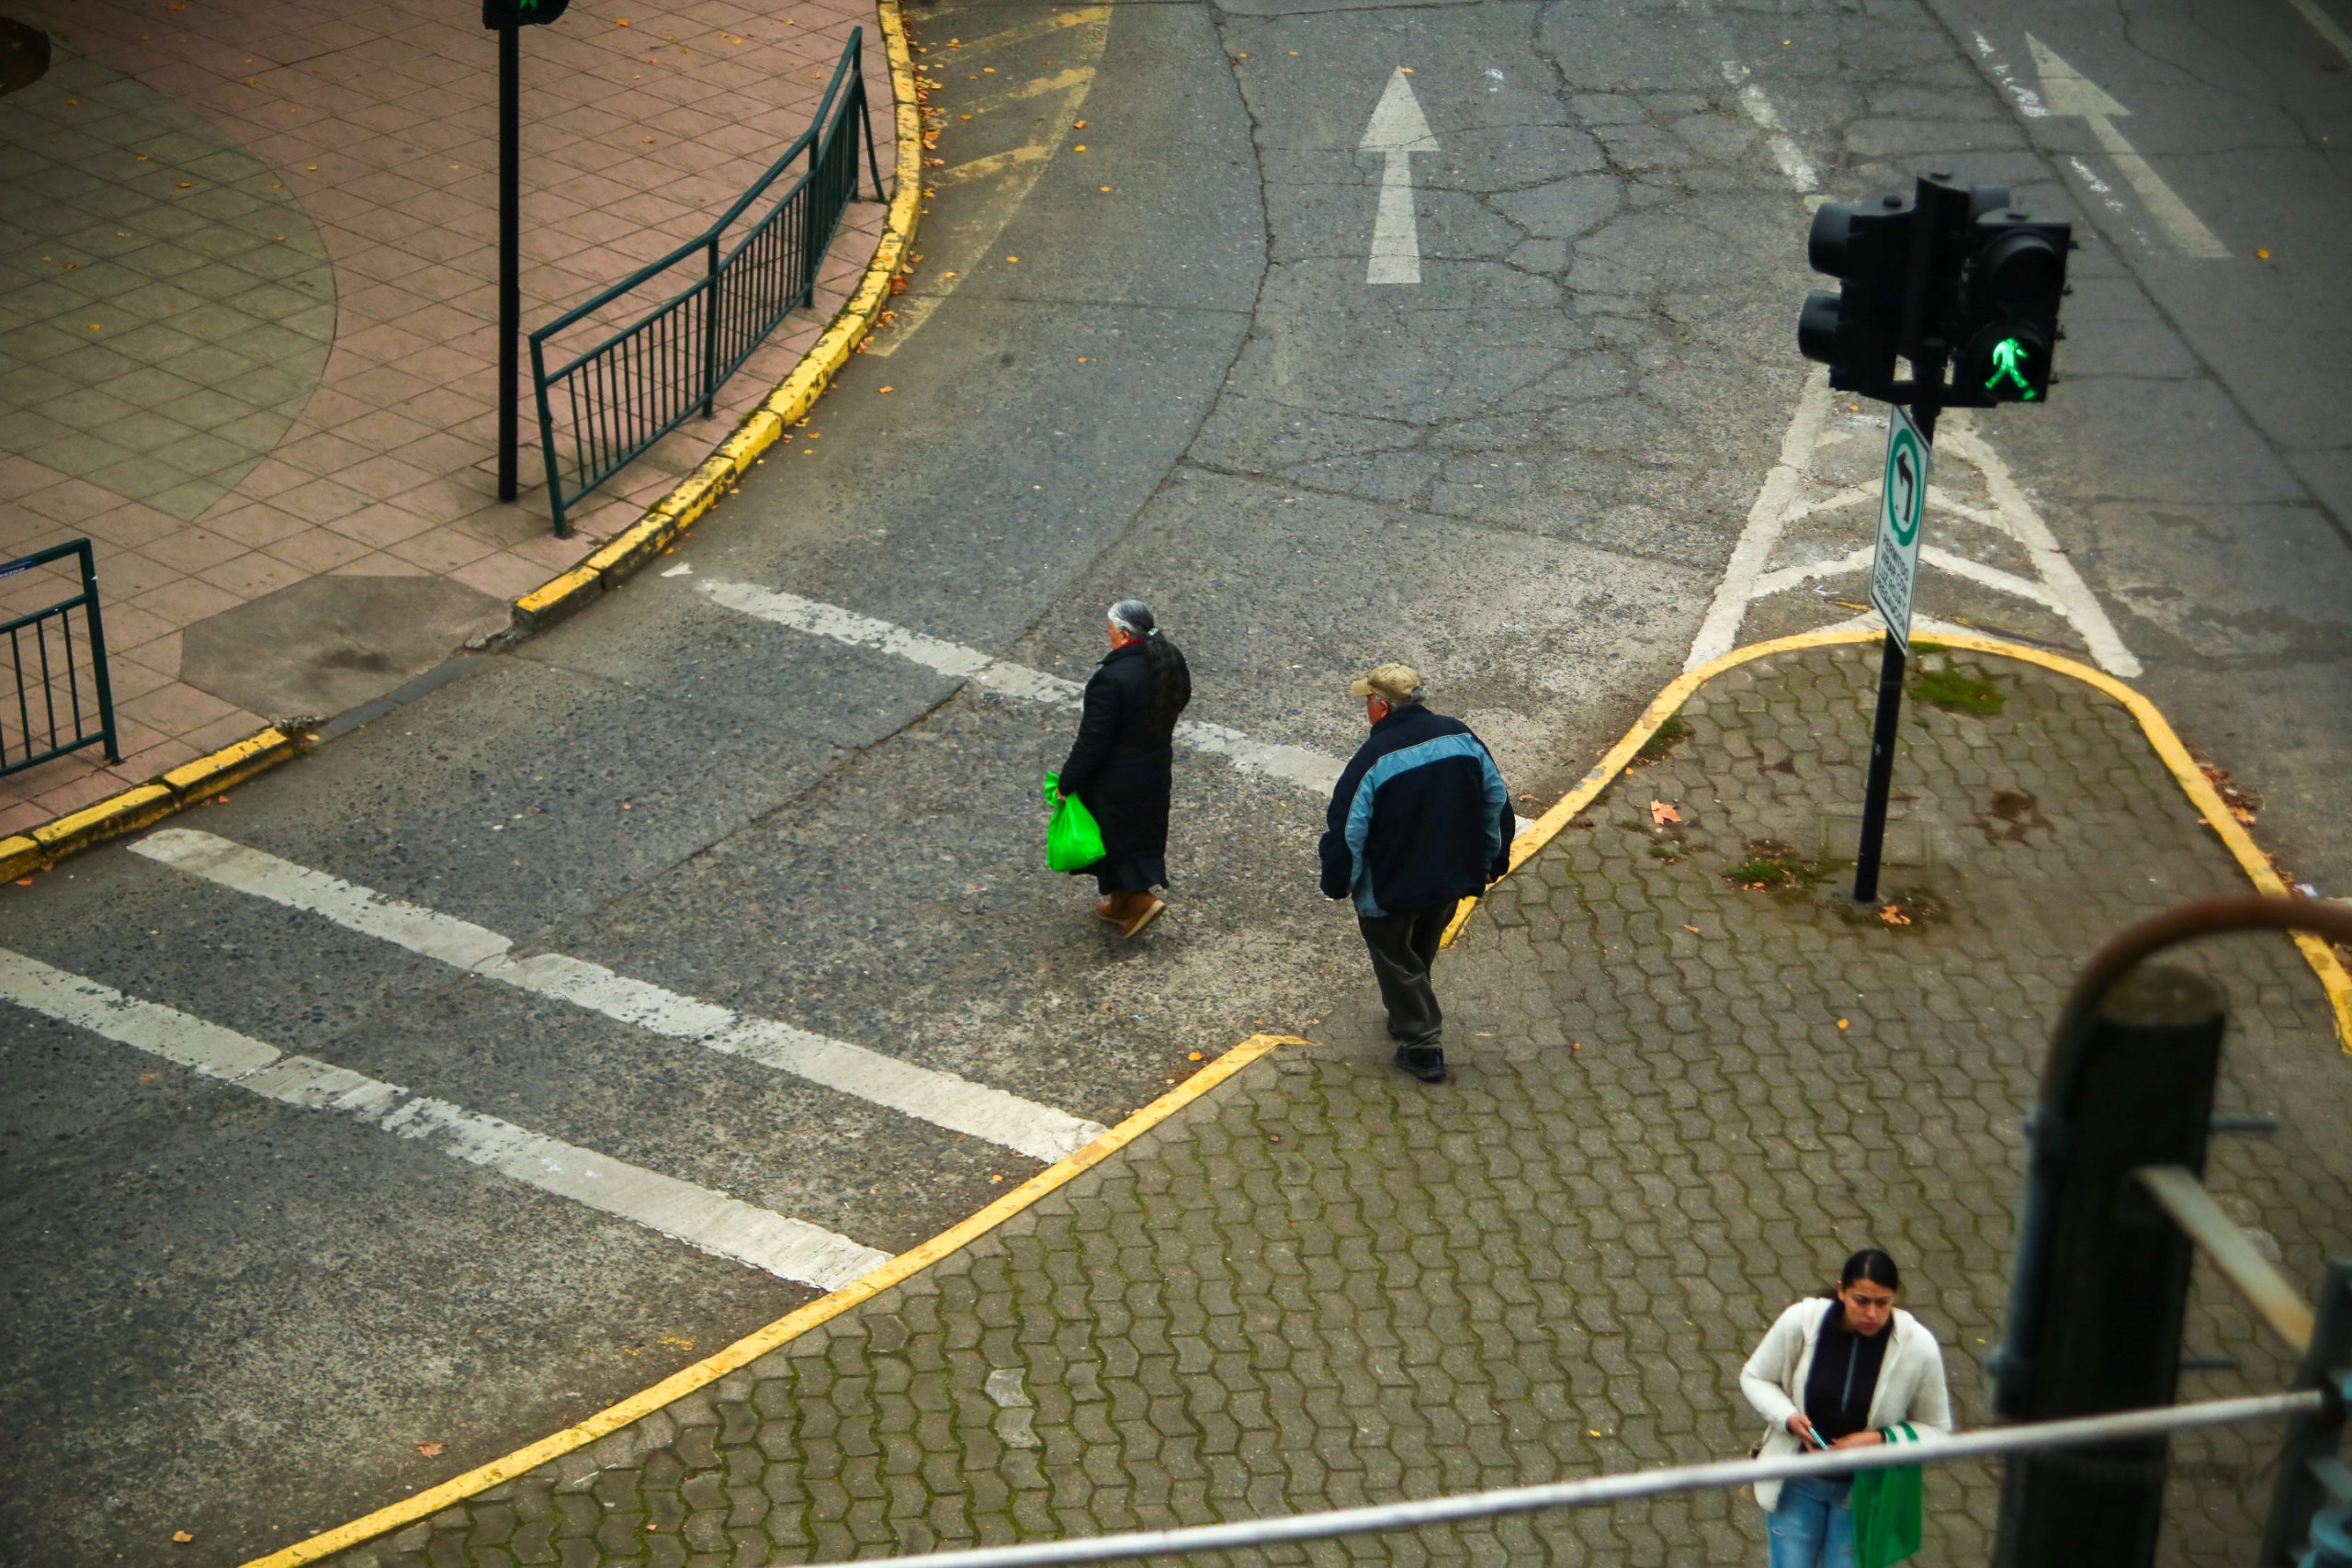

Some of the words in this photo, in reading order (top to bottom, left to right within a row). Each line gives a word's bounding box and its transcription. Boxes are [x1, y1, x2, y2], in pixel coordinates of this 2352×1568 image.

[1882, 547, 1896, 577] VIRAR
[1896, 573, 1907, 596] CON
[1883, 534, 1909, 581] PERMITIDO
[1878, 564, 1888, 585] LUZ
[1888, 579, 1901, 606] ROJA
